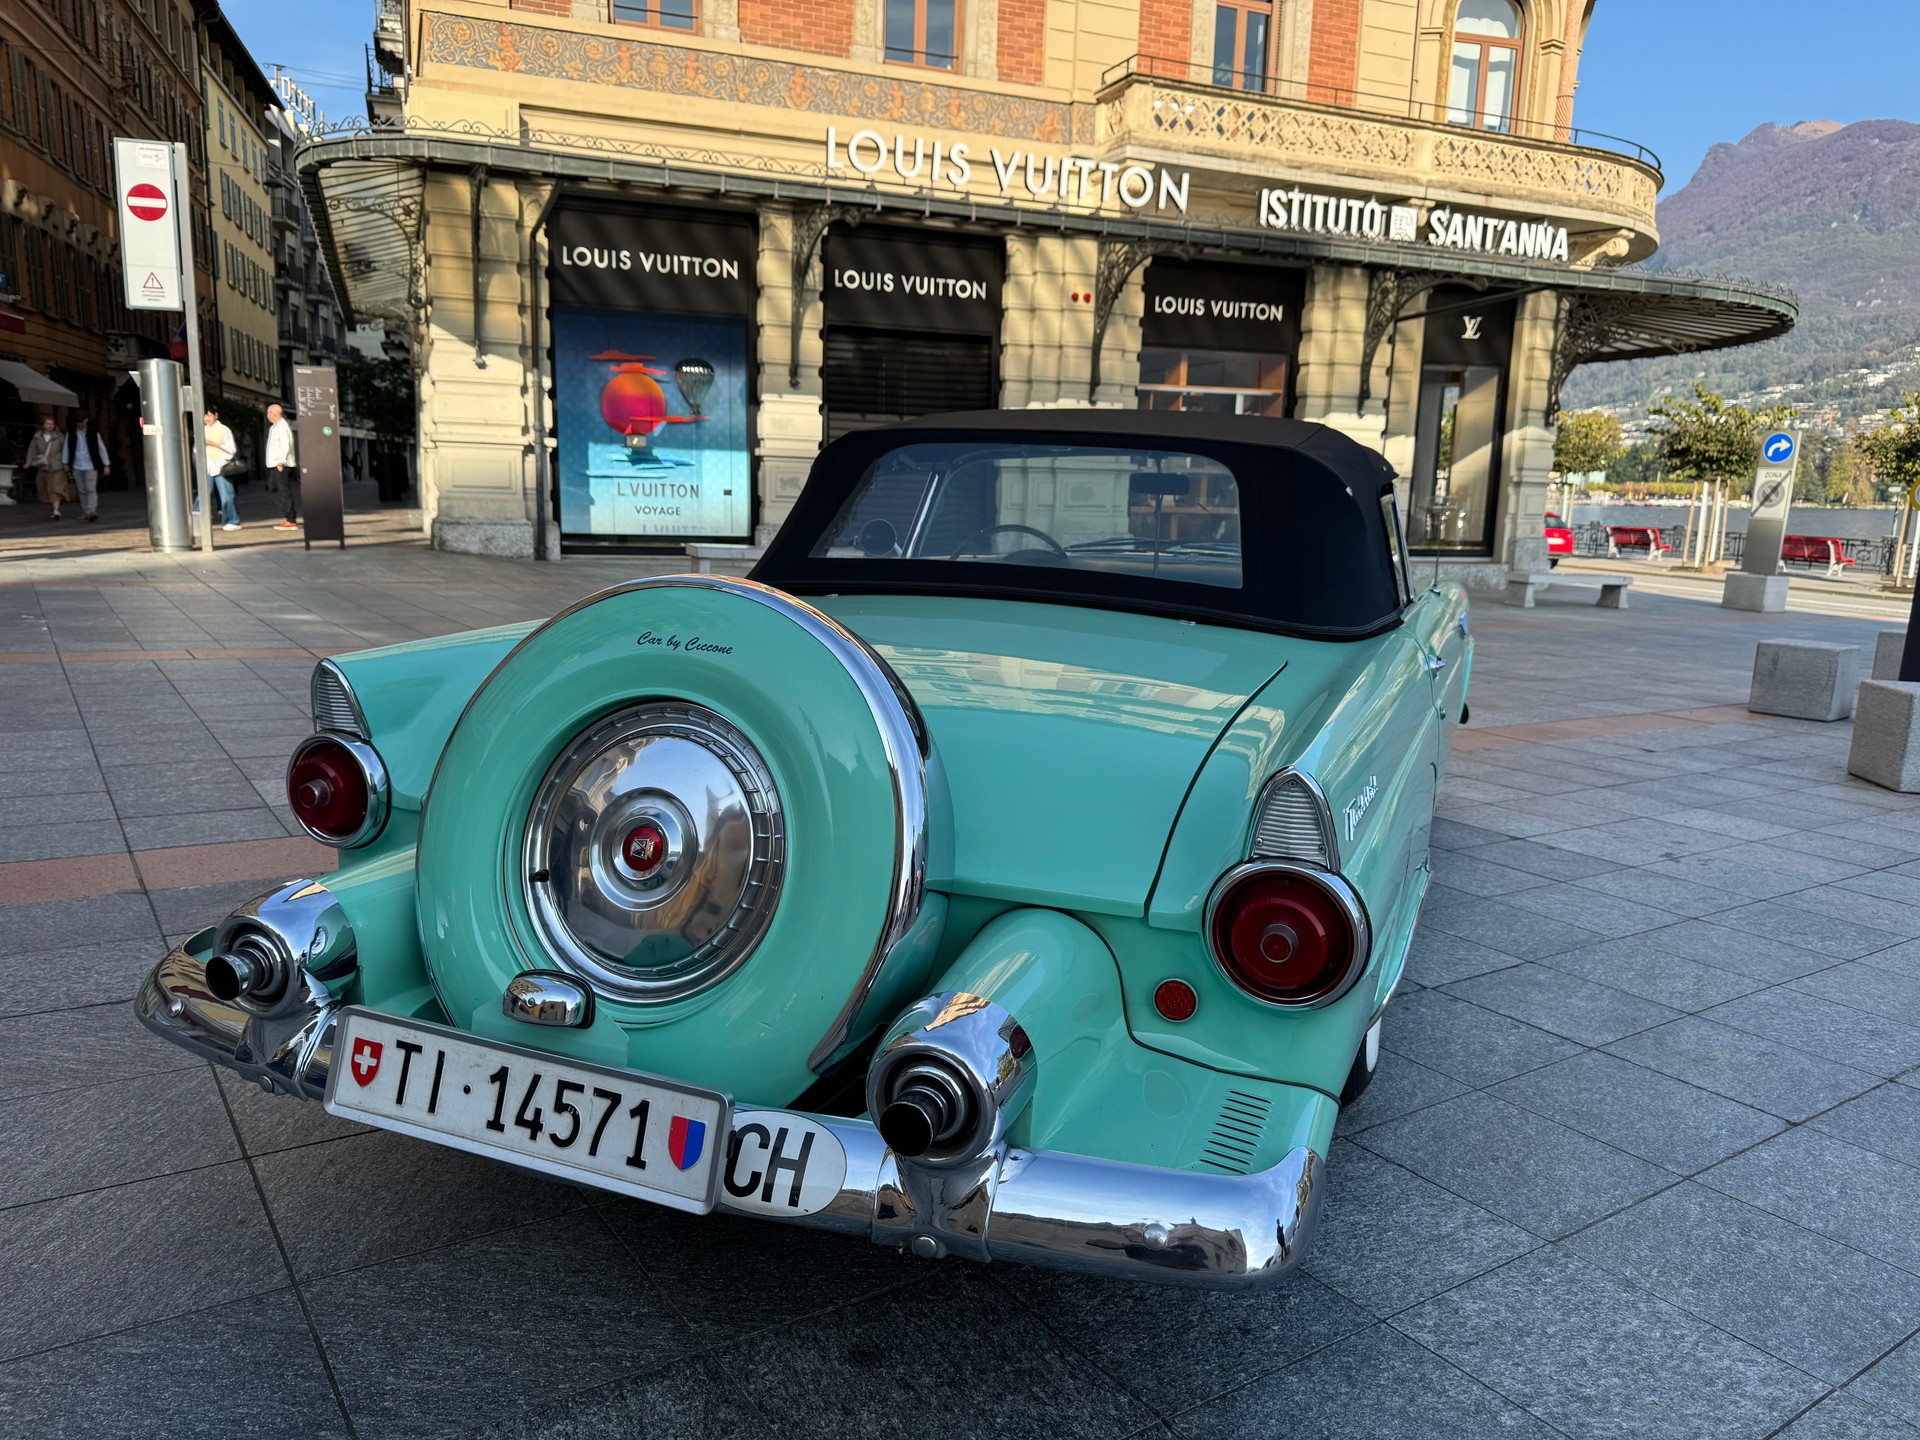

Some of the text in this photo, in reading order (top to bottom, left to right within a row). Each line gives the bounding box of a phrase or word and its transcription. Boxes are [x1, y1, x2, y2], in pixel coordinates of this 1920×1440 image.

[826, 126, 1190, 214] LOUIS VUITTON
[1259, 188, 1568, 261] ISTITUTO SANT'ANNA
[562, 245, 739, 280] LOUIS VUITTON
[834, 268, 987, 300] LOUIS VUITTON
[1154, 295, 1283, 322] LOUIS VUITTON
[634, 505, 681, 516] VOYAGE
[636, 631, 733, 655] Car by Ciccone
[486, 1065, 652, 1170] 14571
[723, 1123, 816, 1208] CH
